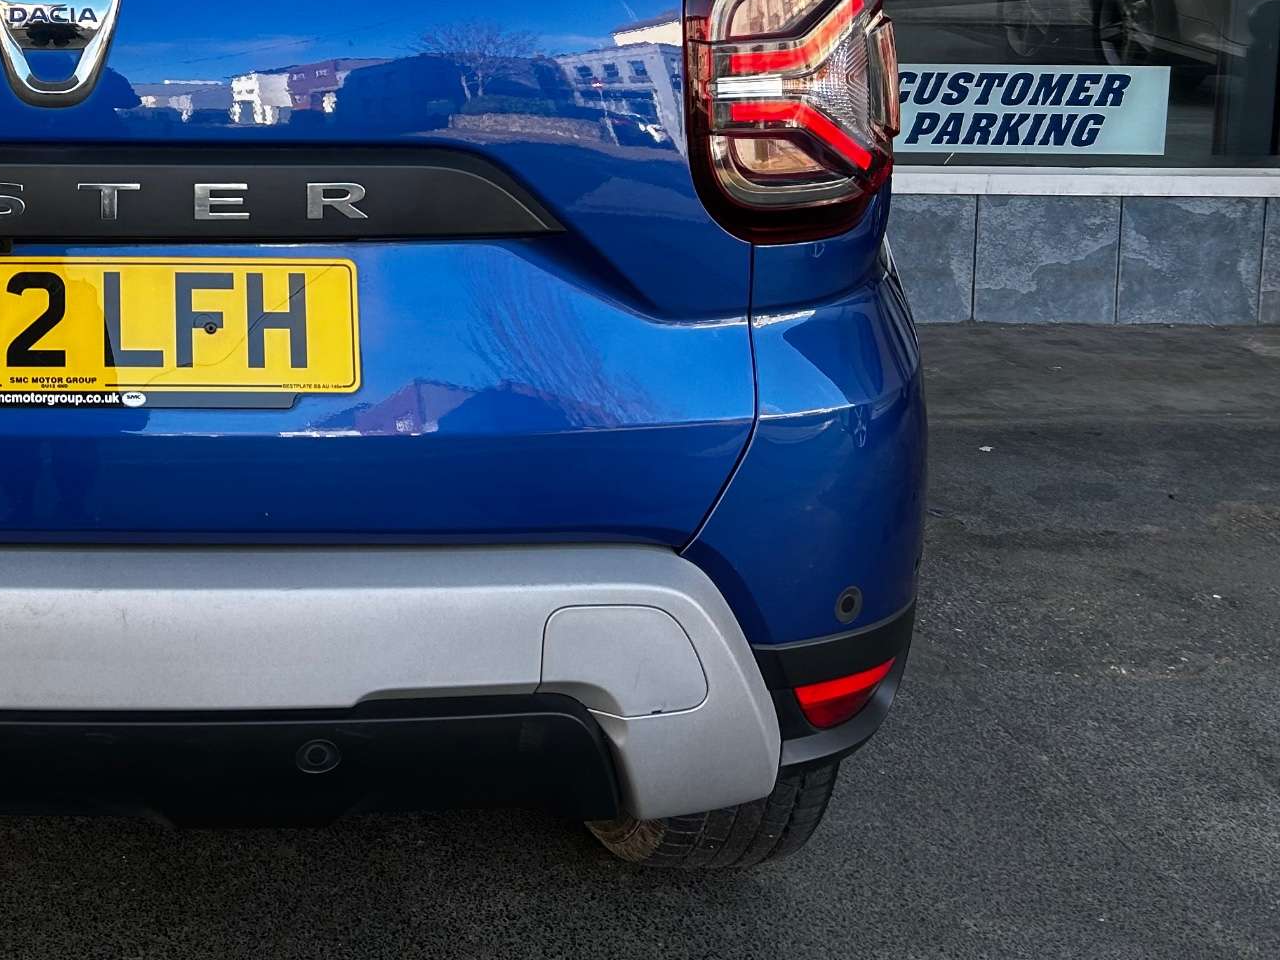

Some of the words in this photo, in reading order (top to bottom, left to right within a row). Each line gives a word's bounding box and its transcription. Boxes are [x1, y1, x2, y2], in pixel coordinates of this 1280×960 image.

[9, 7, 98, 23] DACIA
[898, 72, 1132, 107] CUSTOMER
[904, 112, 1106, 147] PARKING
[103, 272, 307, 368] LFH
[9, 376, 29, 384] SMC
[31, 376, 64, 384] MOTOR
[66, 376, 97, 384] GROUP
